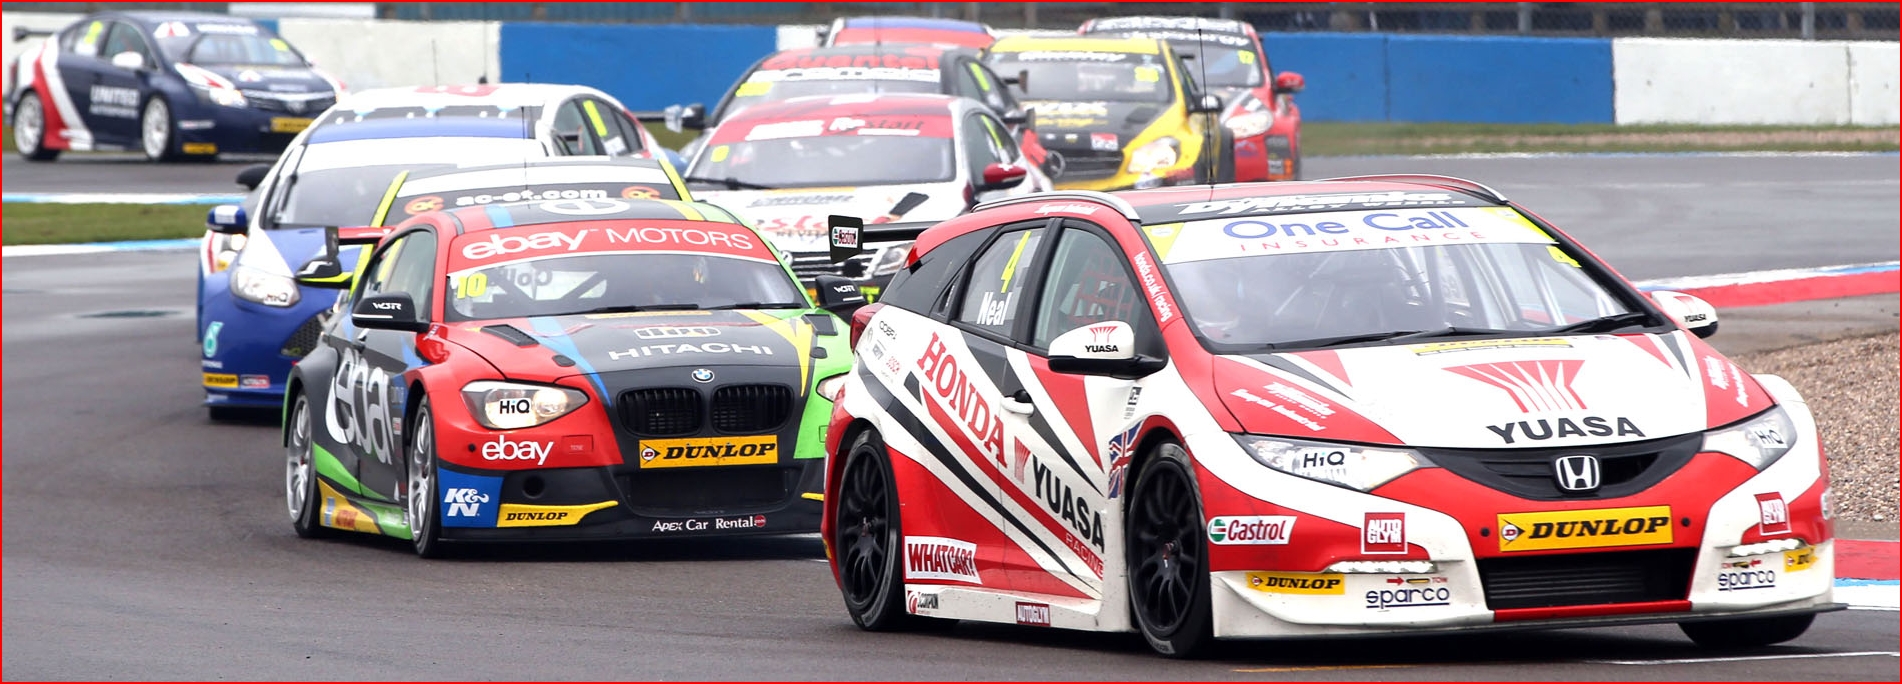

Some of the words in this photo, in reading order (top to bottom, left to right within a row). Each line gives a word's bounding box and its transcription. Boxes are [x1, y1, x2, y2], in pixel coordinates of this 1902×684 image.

[1223, 220, 1349, 239] One
[1363, 211, 1469, 231] Call
[462, 229, 588, 260] ebay
[606, 227, 753, 249] MOTORS
[1241, 231, 1486, 251] INSURANCE
[1001, 230, 1032, 293] 4
[457, 273, 488, 299] 10
[372, 302, 402, 310] WSR
[977, 292, 1012, 325] Neal
[608, 342, 773, 360] HITACHI
[1085, 344, 1119, 353] YUASA
[500, 399, 530, 414] HiQ
[917, 331, 1007, 468] HONDA
[1486, 416, 1646, 444] YUASA
[482, 435, 554, 465] ebay
[663, 442, 776, 460] DUNLOP
[1303, 450, 1345, 468] HiQ
[1033, 454, 1105, 554] YUASA
[505, 513, 568, 521] DUNLOP
[686, 519, 708, 531] Car
[1368, 519, 1403, 532] AUTO
[1529, 516, 1669, 539] DUNLOP
[1227, 519, 1287, 541] Castrol
[1367, 530, 1403, 543] GLYM
[1065, 532, 1105, 576] RACING
[1266, 577, 1341, 590] DUNLOP
[1718, 570, 1775, 592] sparco
[1366, 587, 1450, 609] sparco
